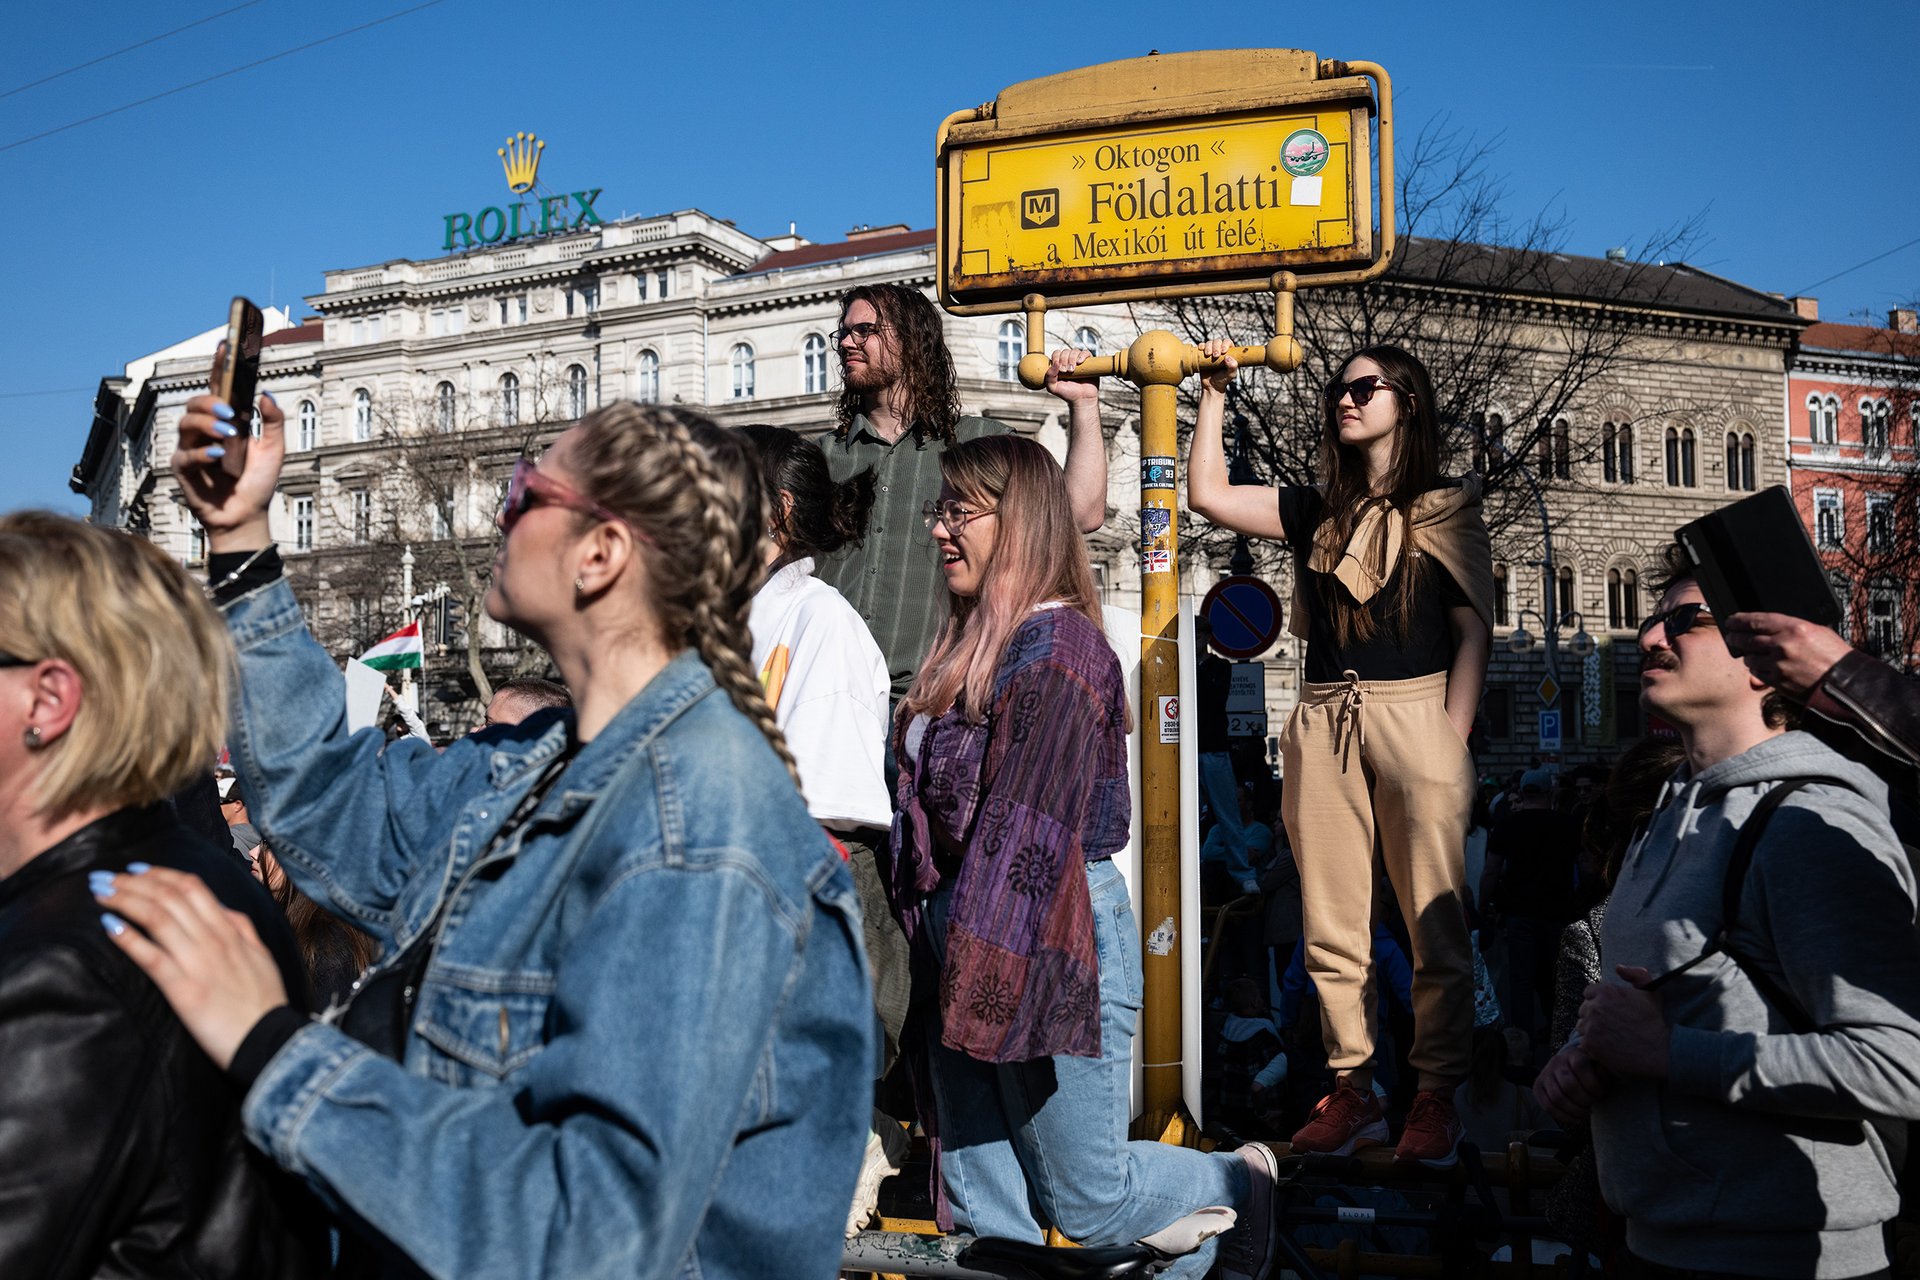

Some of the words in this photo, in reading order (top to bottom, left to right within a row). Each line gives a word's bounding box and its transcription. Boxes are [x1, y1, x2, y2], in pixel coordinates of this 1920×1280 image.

[1095, 142, 1200, 173] Oktogon
[1029, 196, 1051, 213] M
[1087, 165, 1282, 225] Földalatti
[442, 188, 604, 249] ROLEX
[1047, 242, 1059, 262] a
[1073, 227, 1168, 261] Mexikói
[1183, 222, 1206, 251] út
[1216, 218, 1258, 249] felé
[1165, 469, 1174, 479] 93
[1231, 718, 1241, 732] 2
[1544, 715, 1556, 737] P
